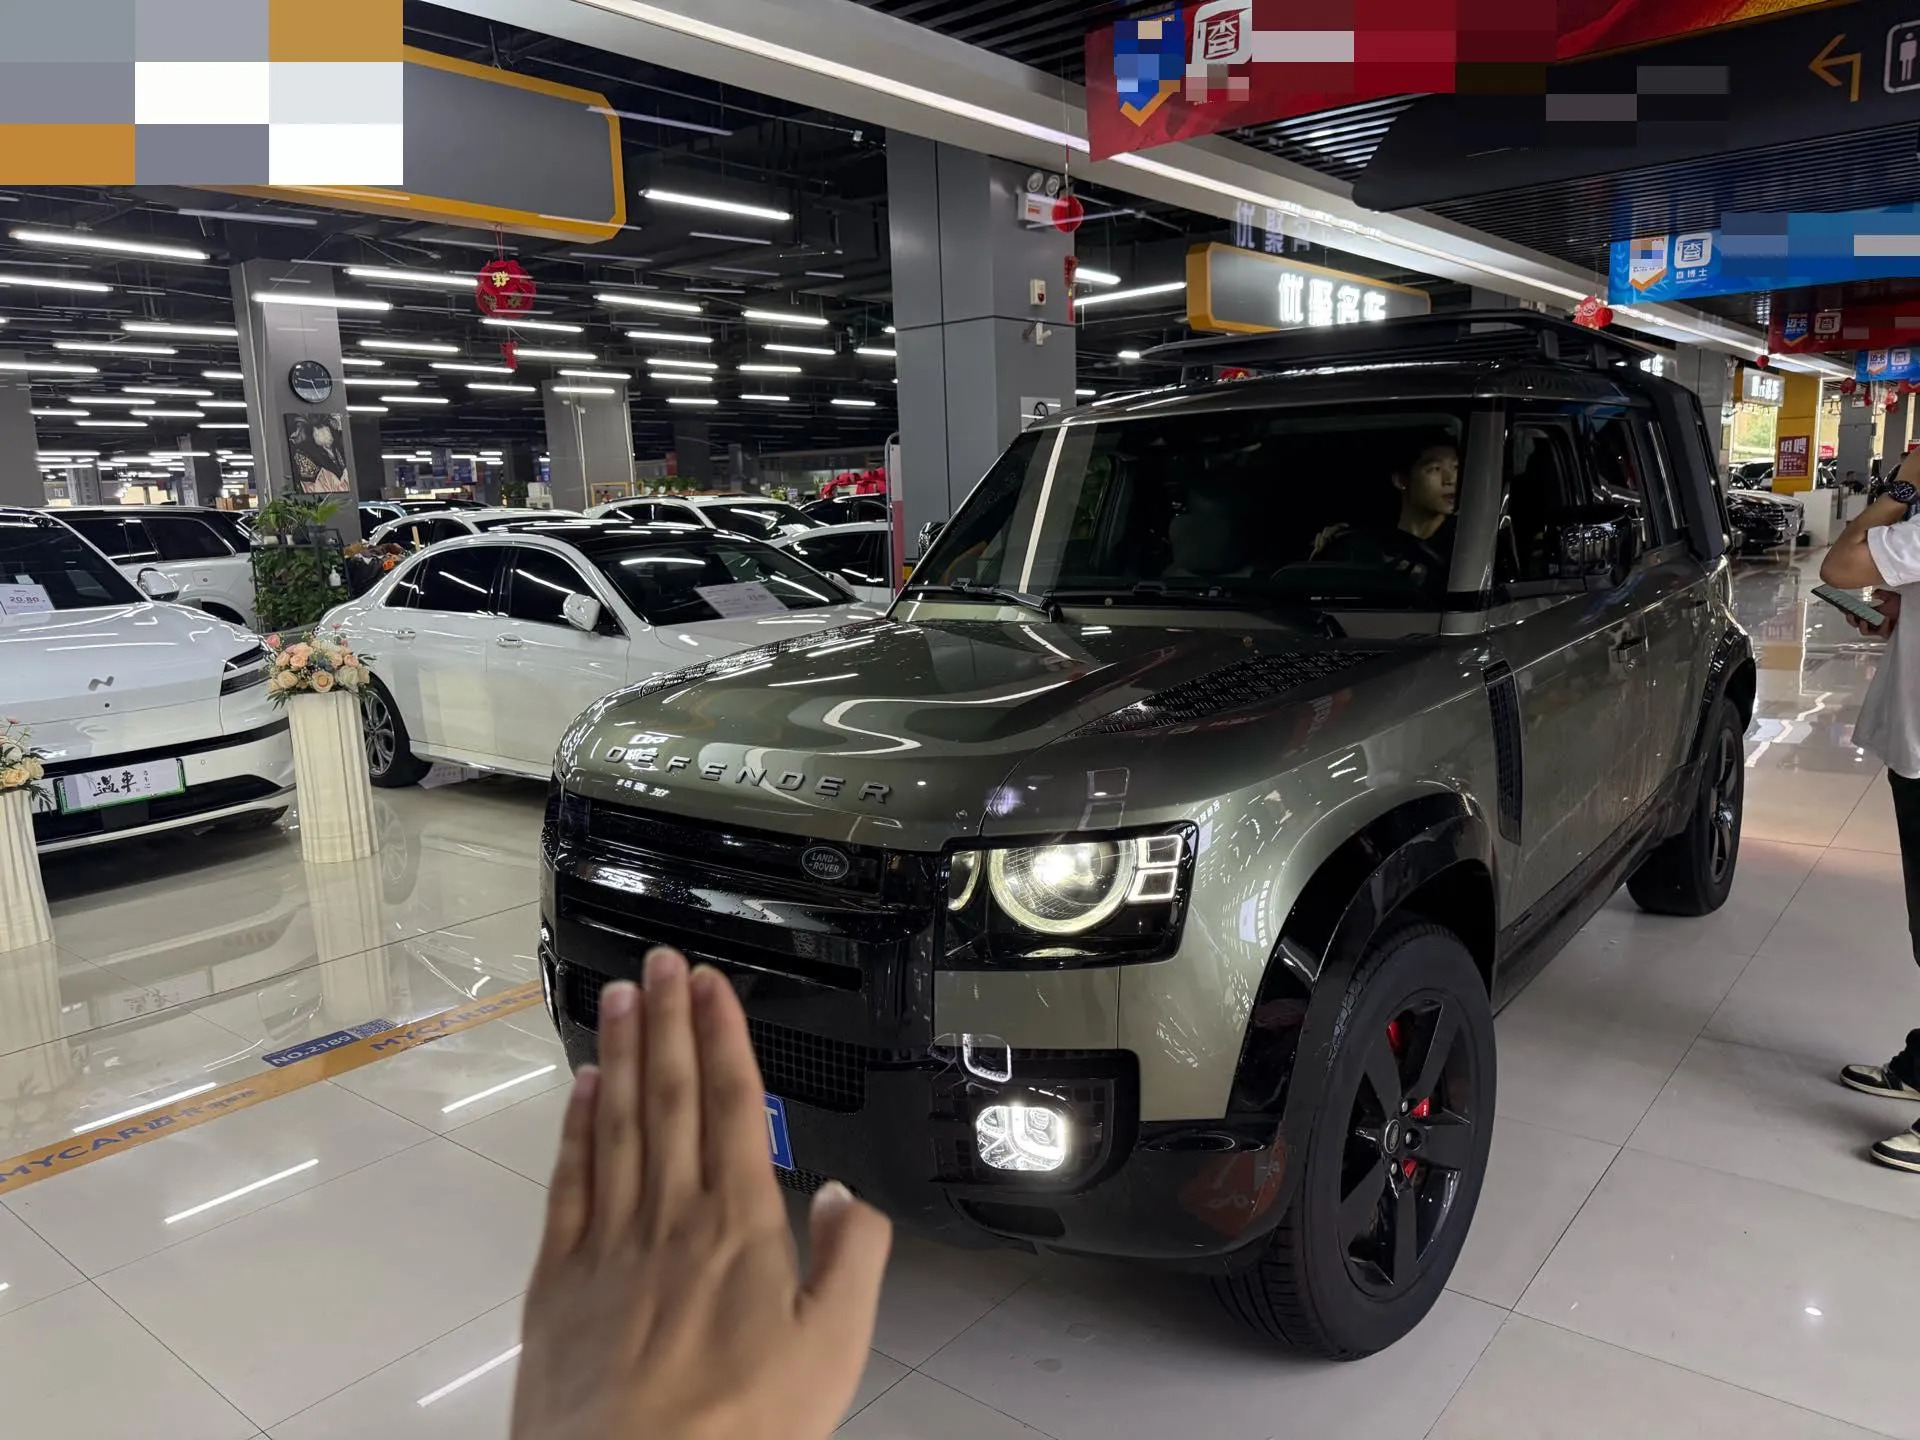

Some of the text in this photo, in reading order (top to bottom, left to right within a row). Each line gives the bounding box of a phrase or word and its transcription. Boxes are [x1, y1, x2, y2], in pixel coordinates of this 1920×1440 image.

[604, 746, 891, 804] DEFENDER
[812, 852, 834, 863] LAND
[813, 861, 840, 873] ROVER
[271, 1035, 352, 1064] NO.2189
